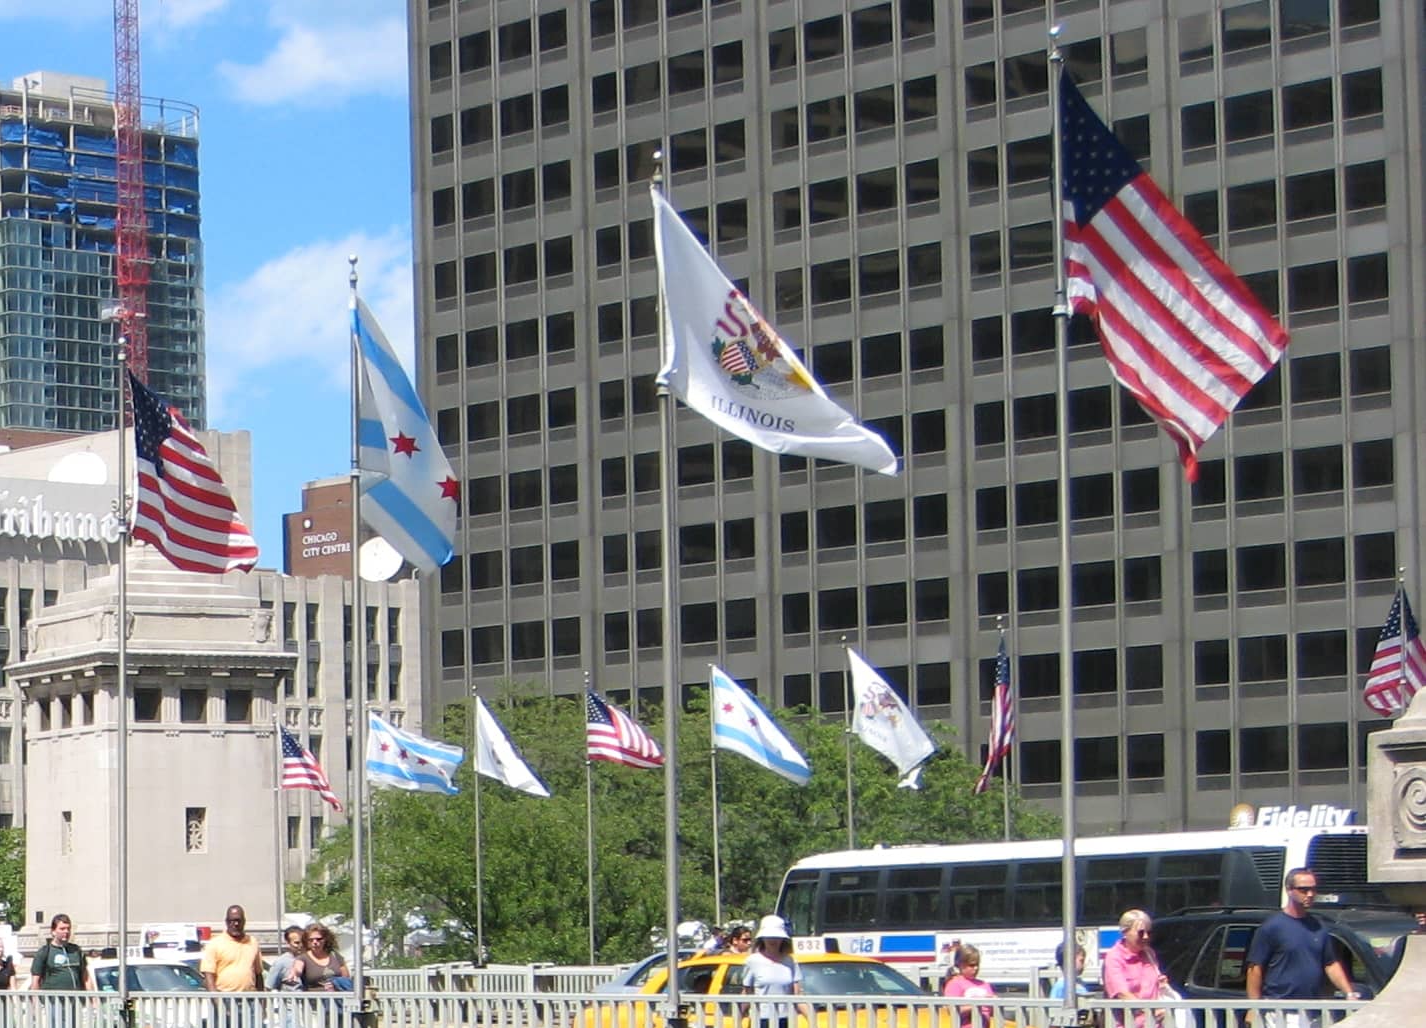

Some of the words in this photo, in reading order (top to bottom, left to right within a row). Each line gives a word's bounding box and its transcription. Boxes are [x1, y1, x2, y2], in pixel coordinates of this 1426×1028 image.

[711, 395, 796, 433] ILLINOIS
[302, 531, 338, 545] CHICAGO
[302, 546, 320, 558] CITY
[321, 542, 351, 555] CENTRE
[1256, 804, 1352, 827] Fidelity
